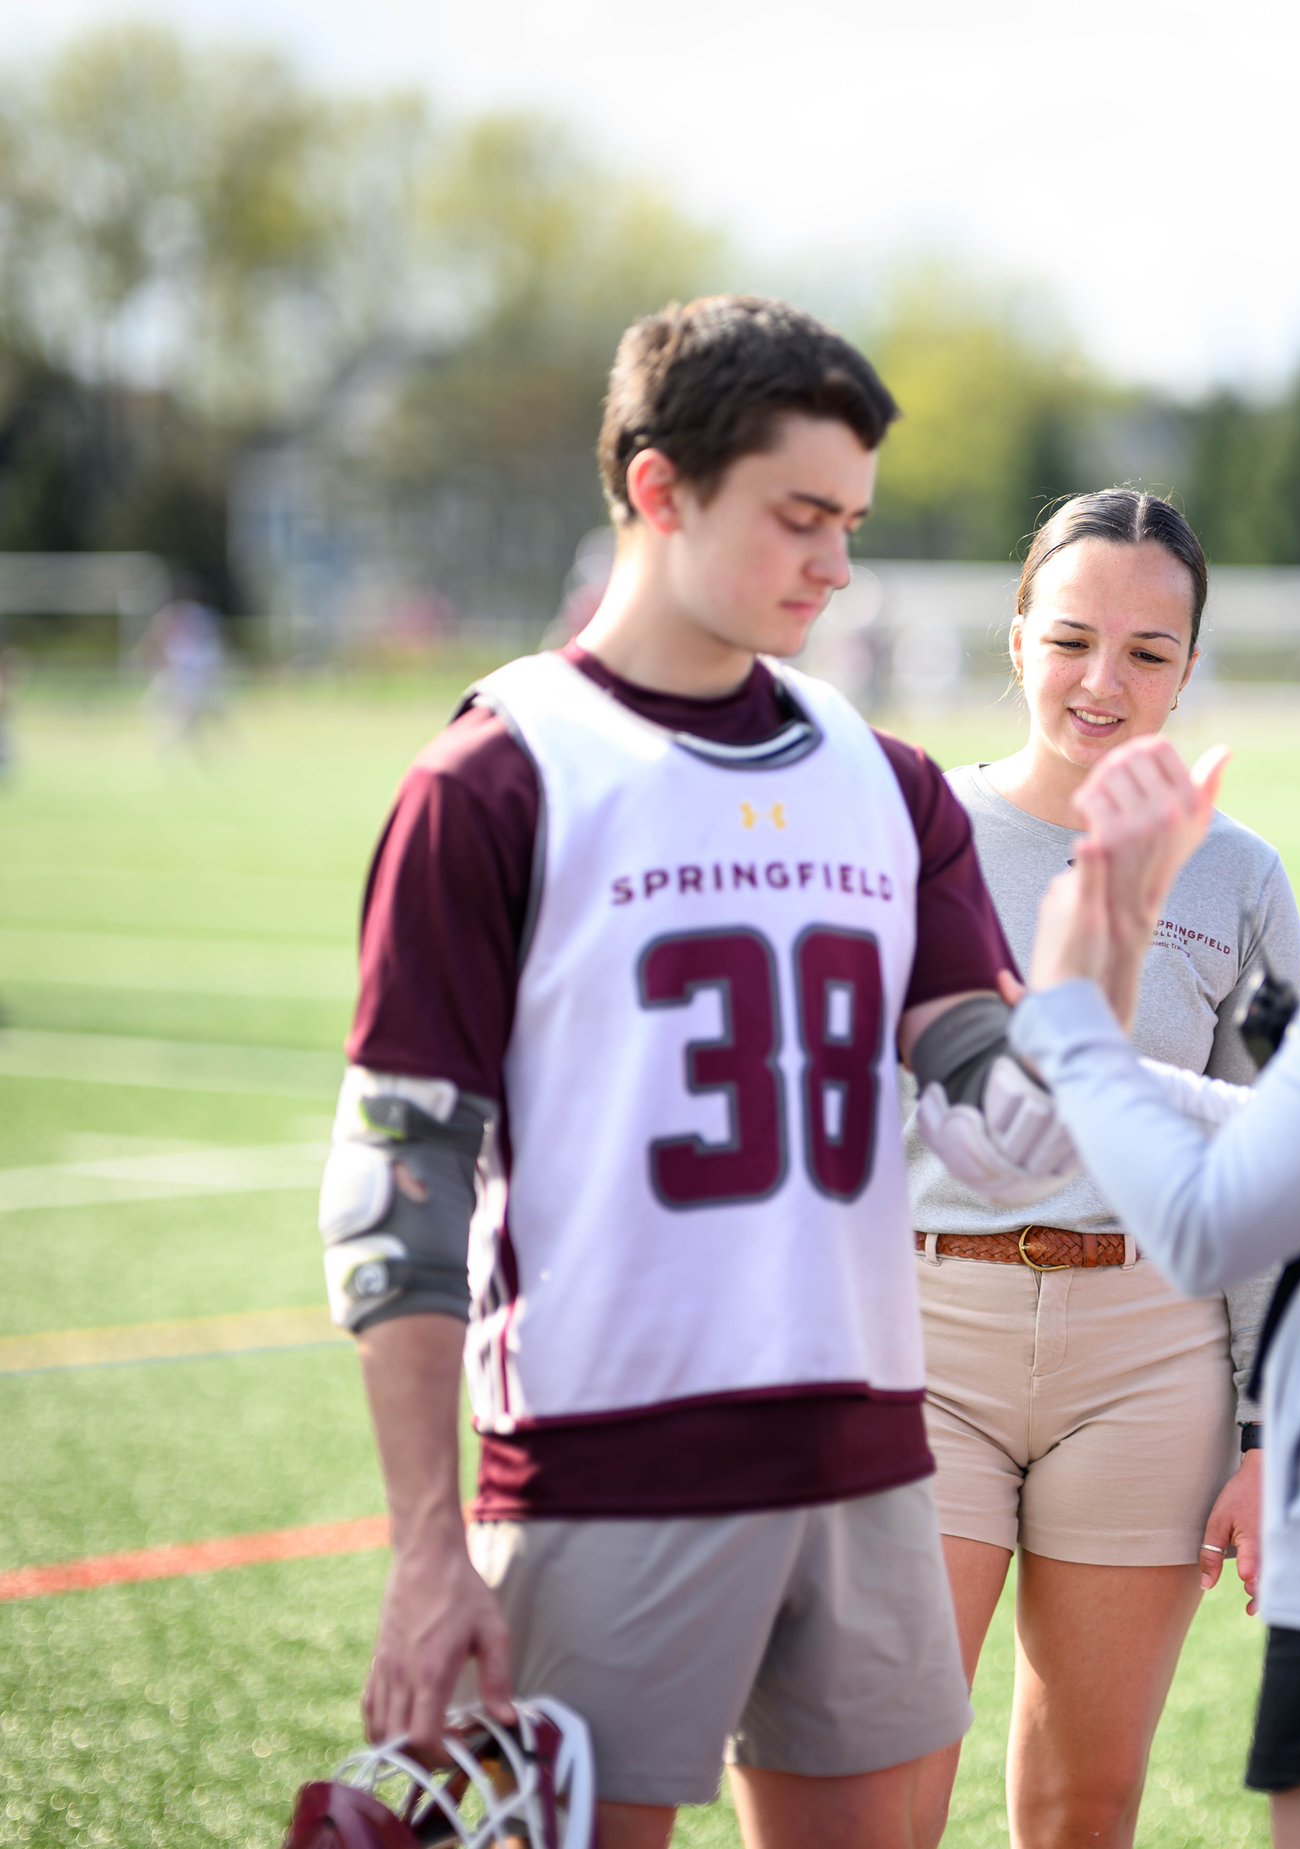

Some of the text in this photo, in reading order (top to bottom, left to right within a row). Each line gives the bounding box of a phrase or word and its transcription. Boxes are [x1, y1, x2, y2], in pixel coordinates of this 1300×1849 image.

[610, 862, 894, 906] SPRINGFIELD
[1148, 940, 1170, 950] thletic
[1153, 930, 1189, 946] OLLEE
[1156, 919, 1231, 955] PRINGFIELD
[635, 921, 887, 1214] 38
